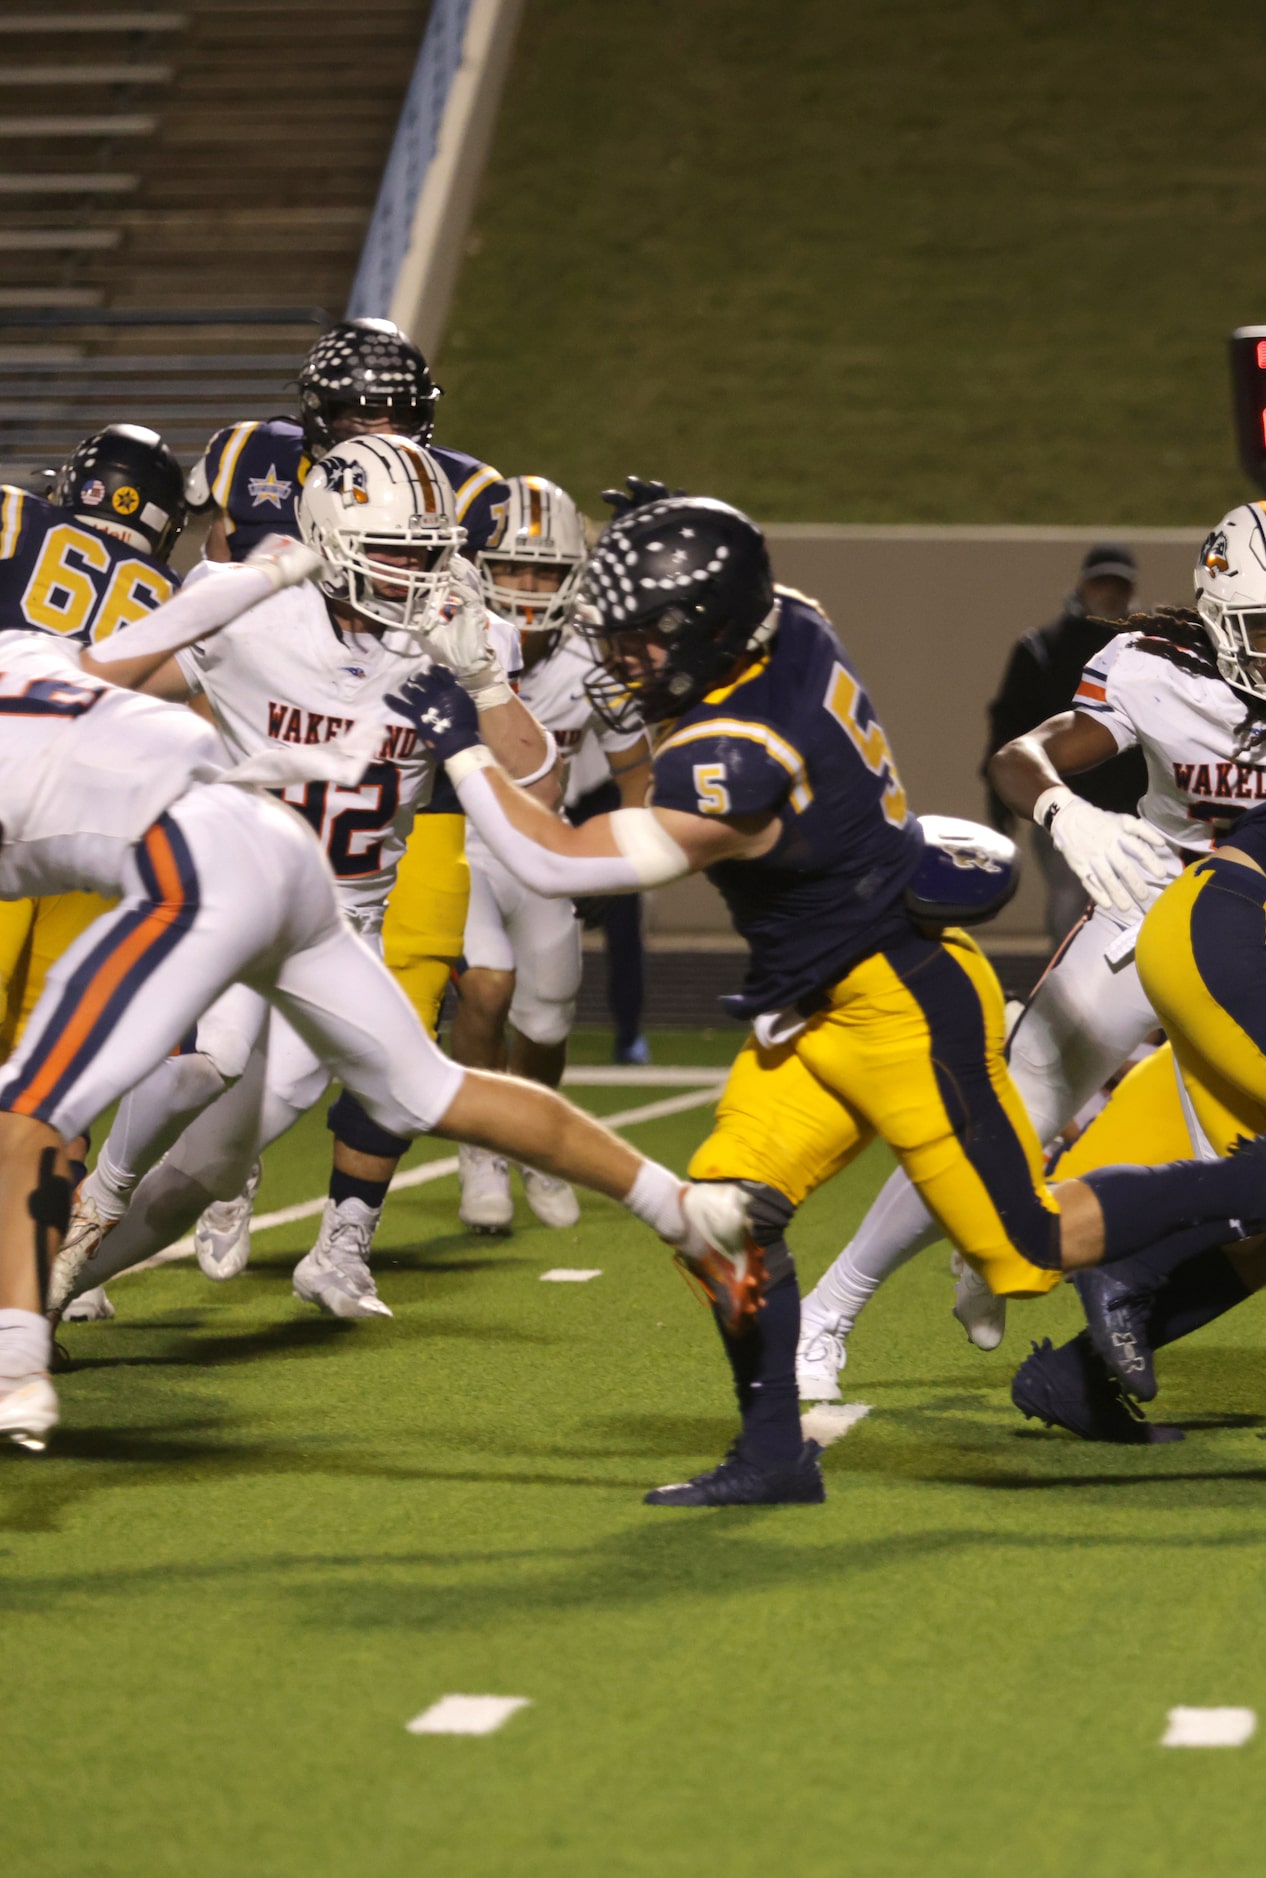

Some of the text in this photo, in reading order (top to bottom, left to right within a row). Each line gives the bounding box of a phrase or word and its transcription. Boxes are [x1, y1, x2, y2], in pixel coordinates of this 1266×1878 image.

[20, 523, 174, 644] 66
[268, 701, 419, 759] WAKEND
[823, 660, 907, 830] 5
[693, 763, 731, 815] 5
